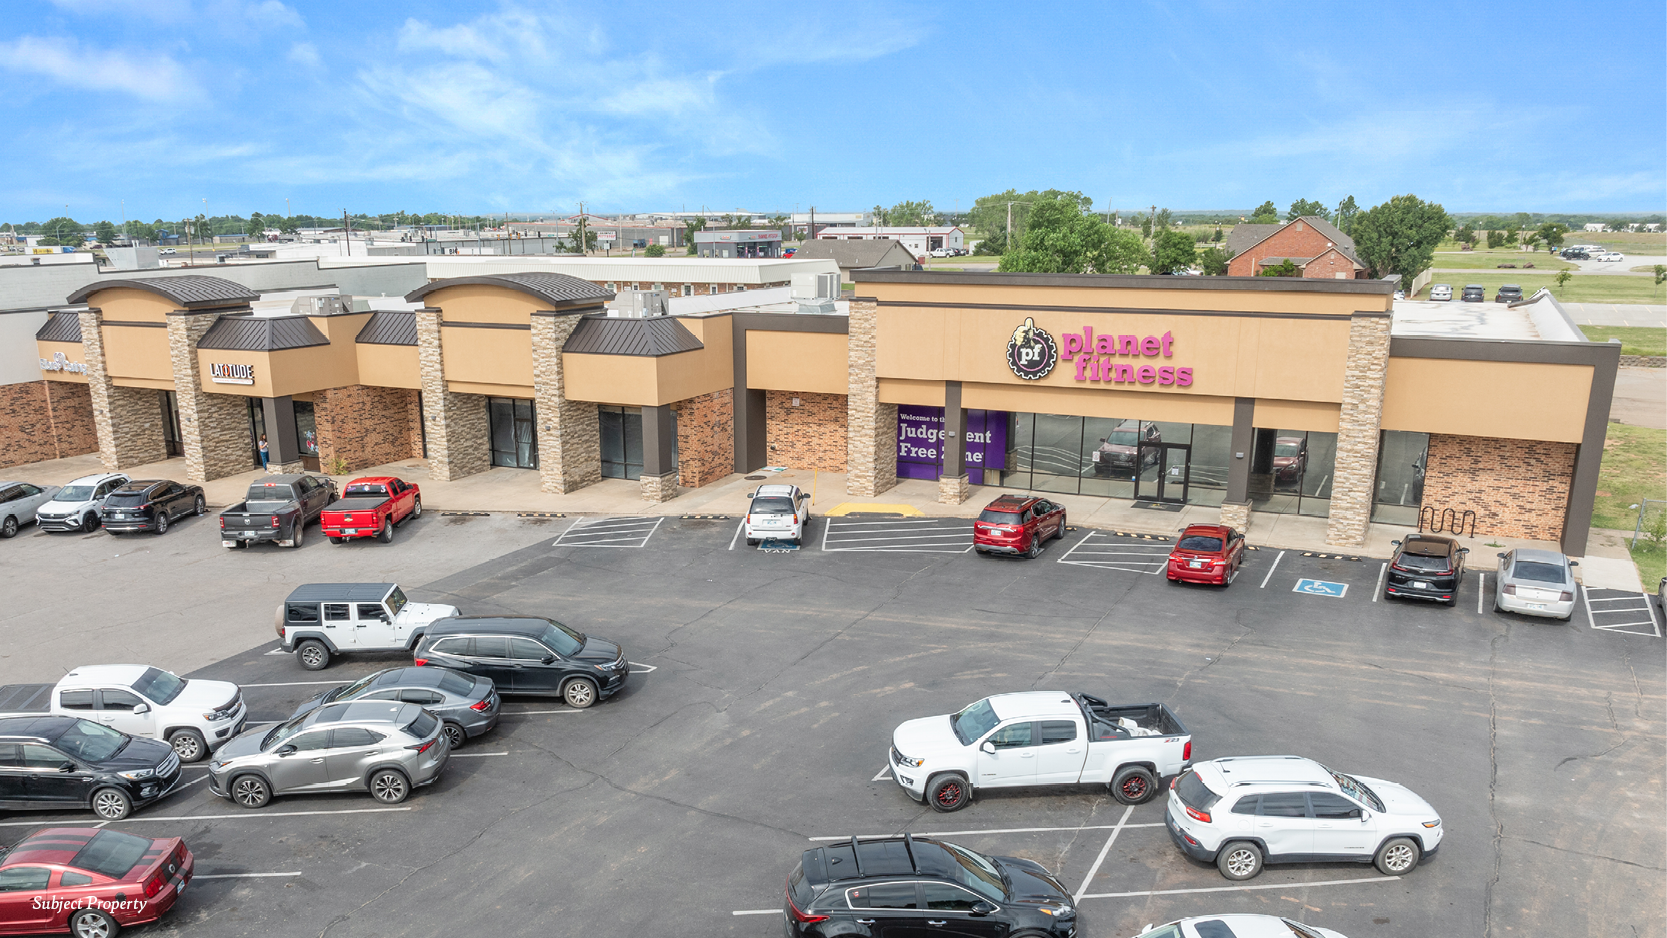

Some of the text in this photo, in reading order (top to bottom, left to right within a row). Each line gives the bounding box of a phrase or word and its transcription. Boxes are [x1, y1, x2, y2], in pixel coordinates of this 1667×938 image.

[1060, 325, 1174, 360] planet
[1019, 343, 1043, 365] pf
[209, 363, 254, 379] LATITUDE
[1074, 354, 1193, 386] fitness
[899, 413, 930, 422] Welcome
[899, 423, 992, 443] Judgeent
[899, 442, 937, 459] Free
